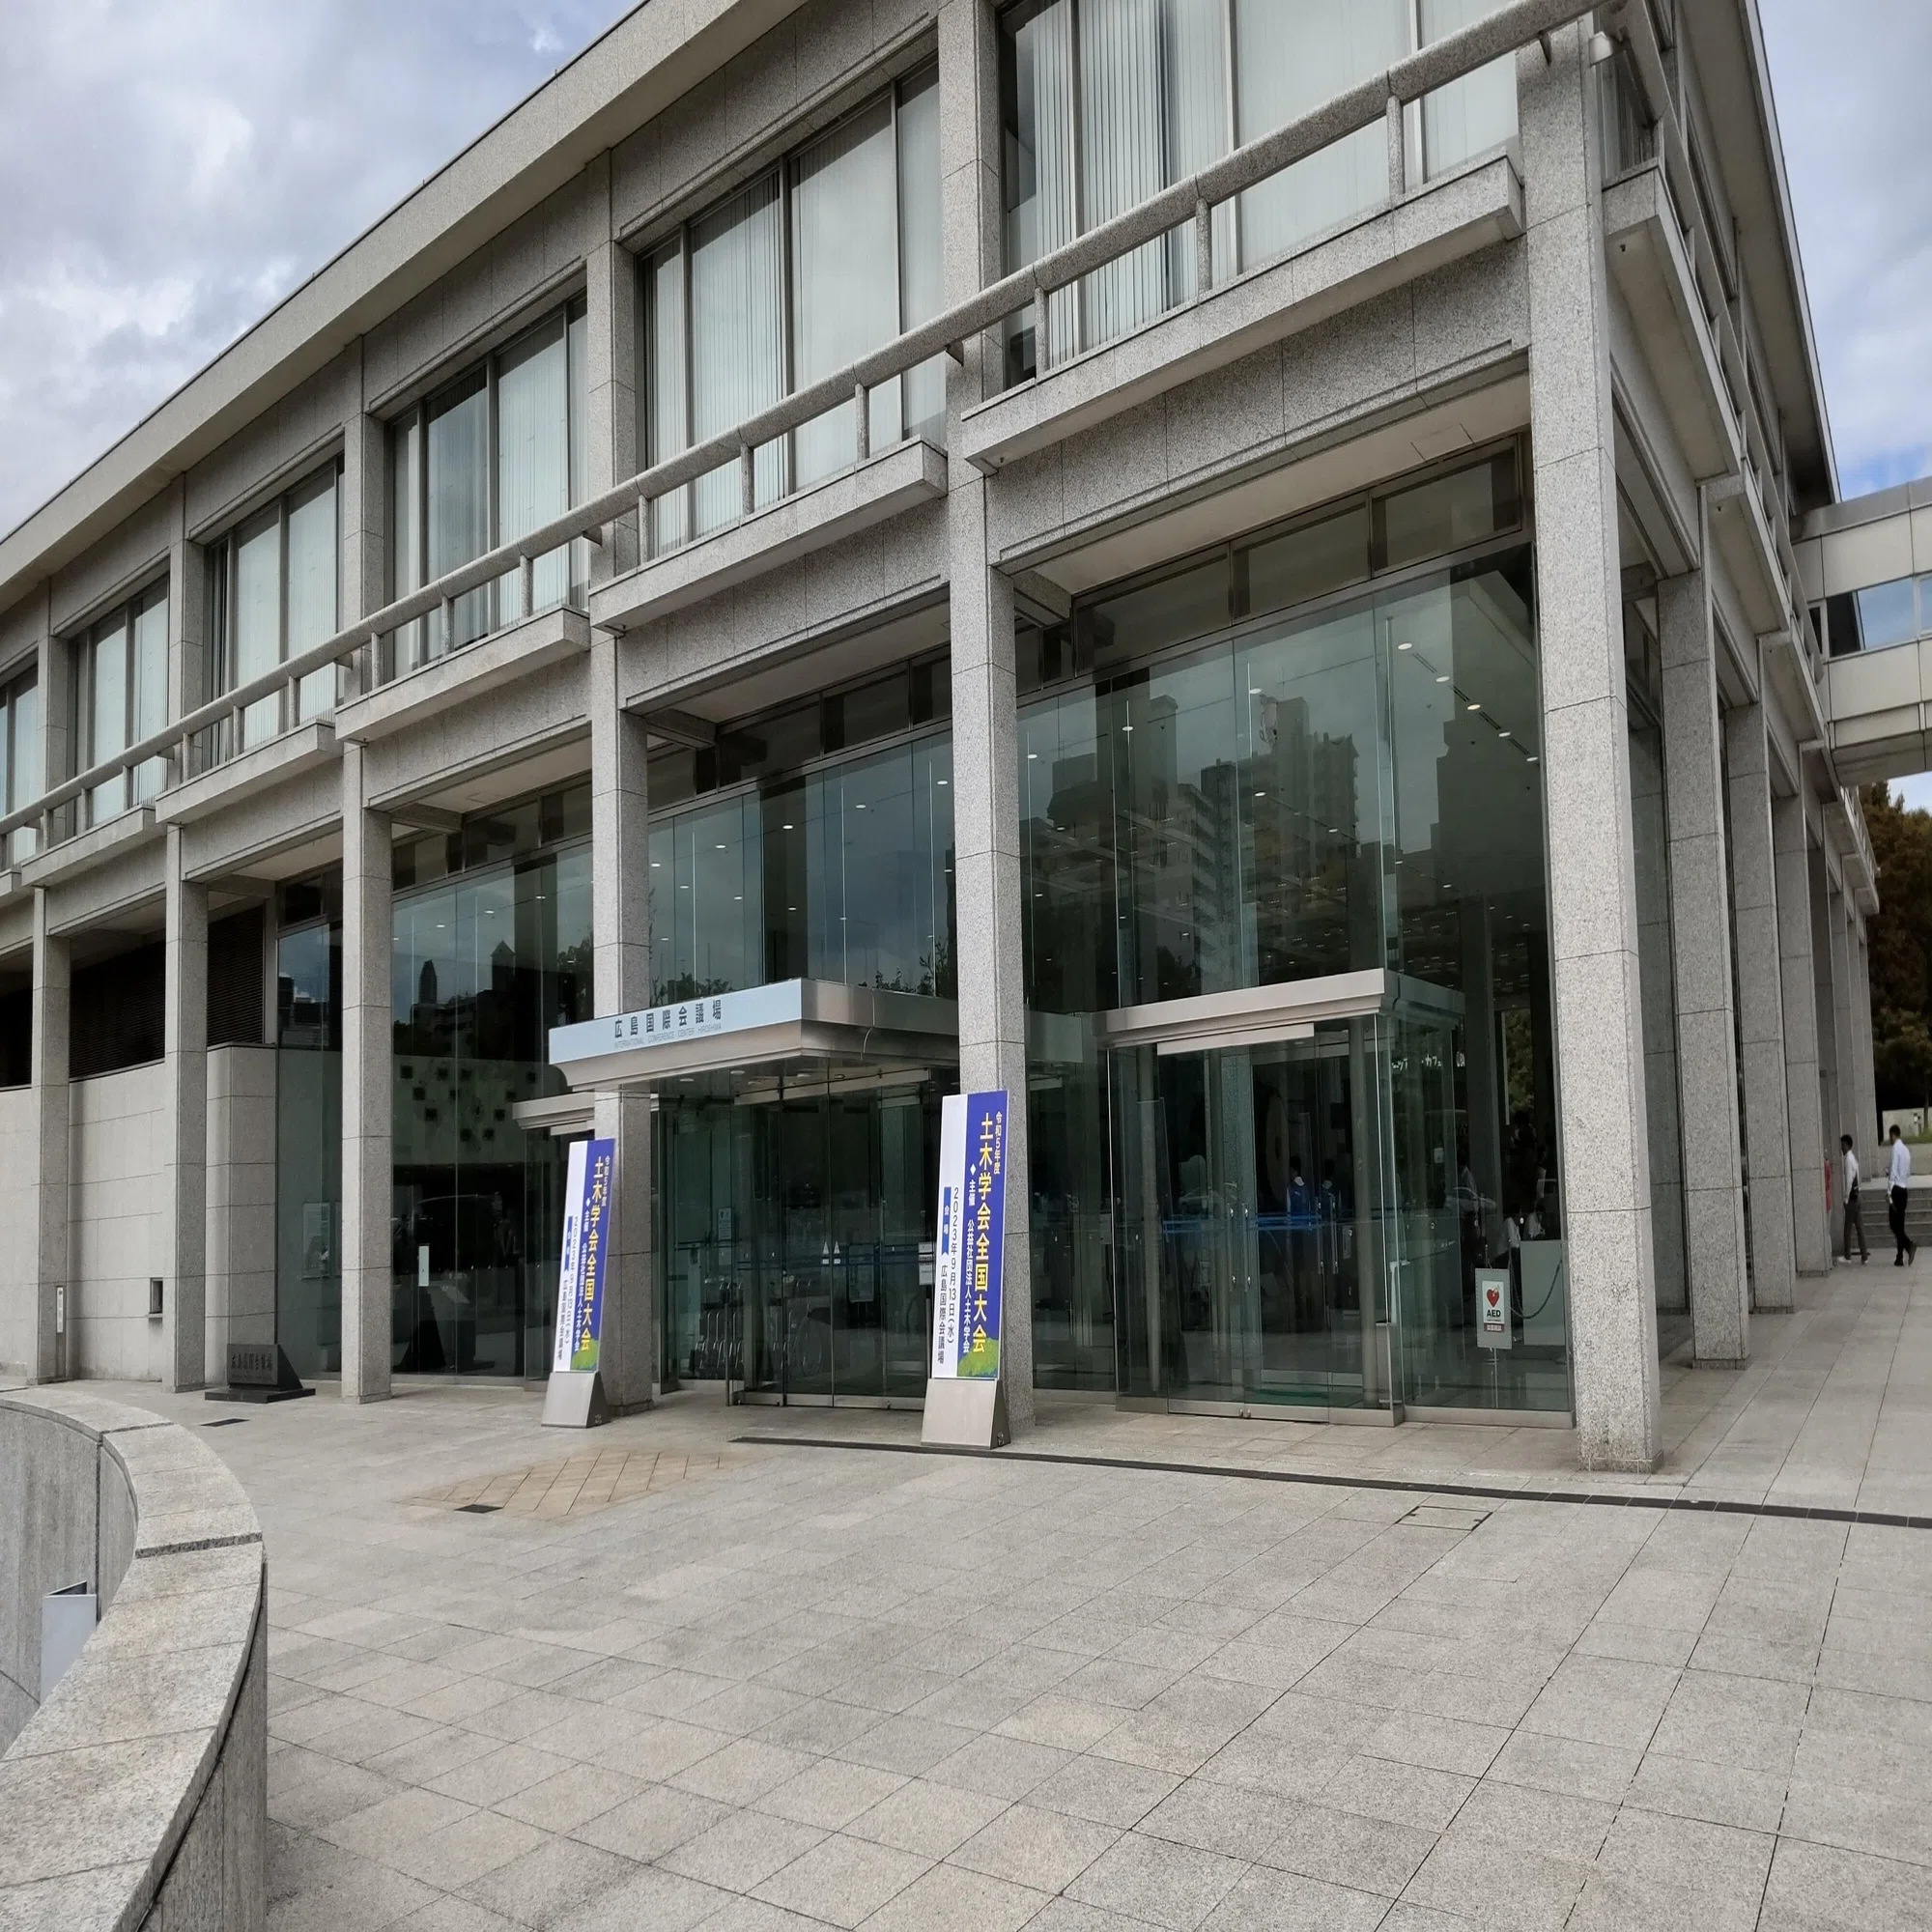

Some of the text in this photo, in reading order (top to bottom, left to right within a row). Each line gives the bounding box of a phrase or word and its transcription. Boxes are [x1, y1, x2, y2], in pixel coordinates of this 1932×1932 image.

[615, 1000, 722, 1038] 広島国際会議場
[648, 1030, 674, 1043] CONFERENCE
[678, 1027, 695, 1038] CENTER
[697, 1023, 722, 1035] HIROSHIMA
[994, 1111, 1003, 1175] 令和5年度
[581, 1155, 604, 1351] 土木学会全国大会
[972, 1112, 994, 1353] 土木学会全国大会
[937, 1264, 948, 1364] 広島国際会議場
[963, 1219, 975, 1353] 公益社団法人土木学会
[1487, 1309, 1501, 1318] AED
